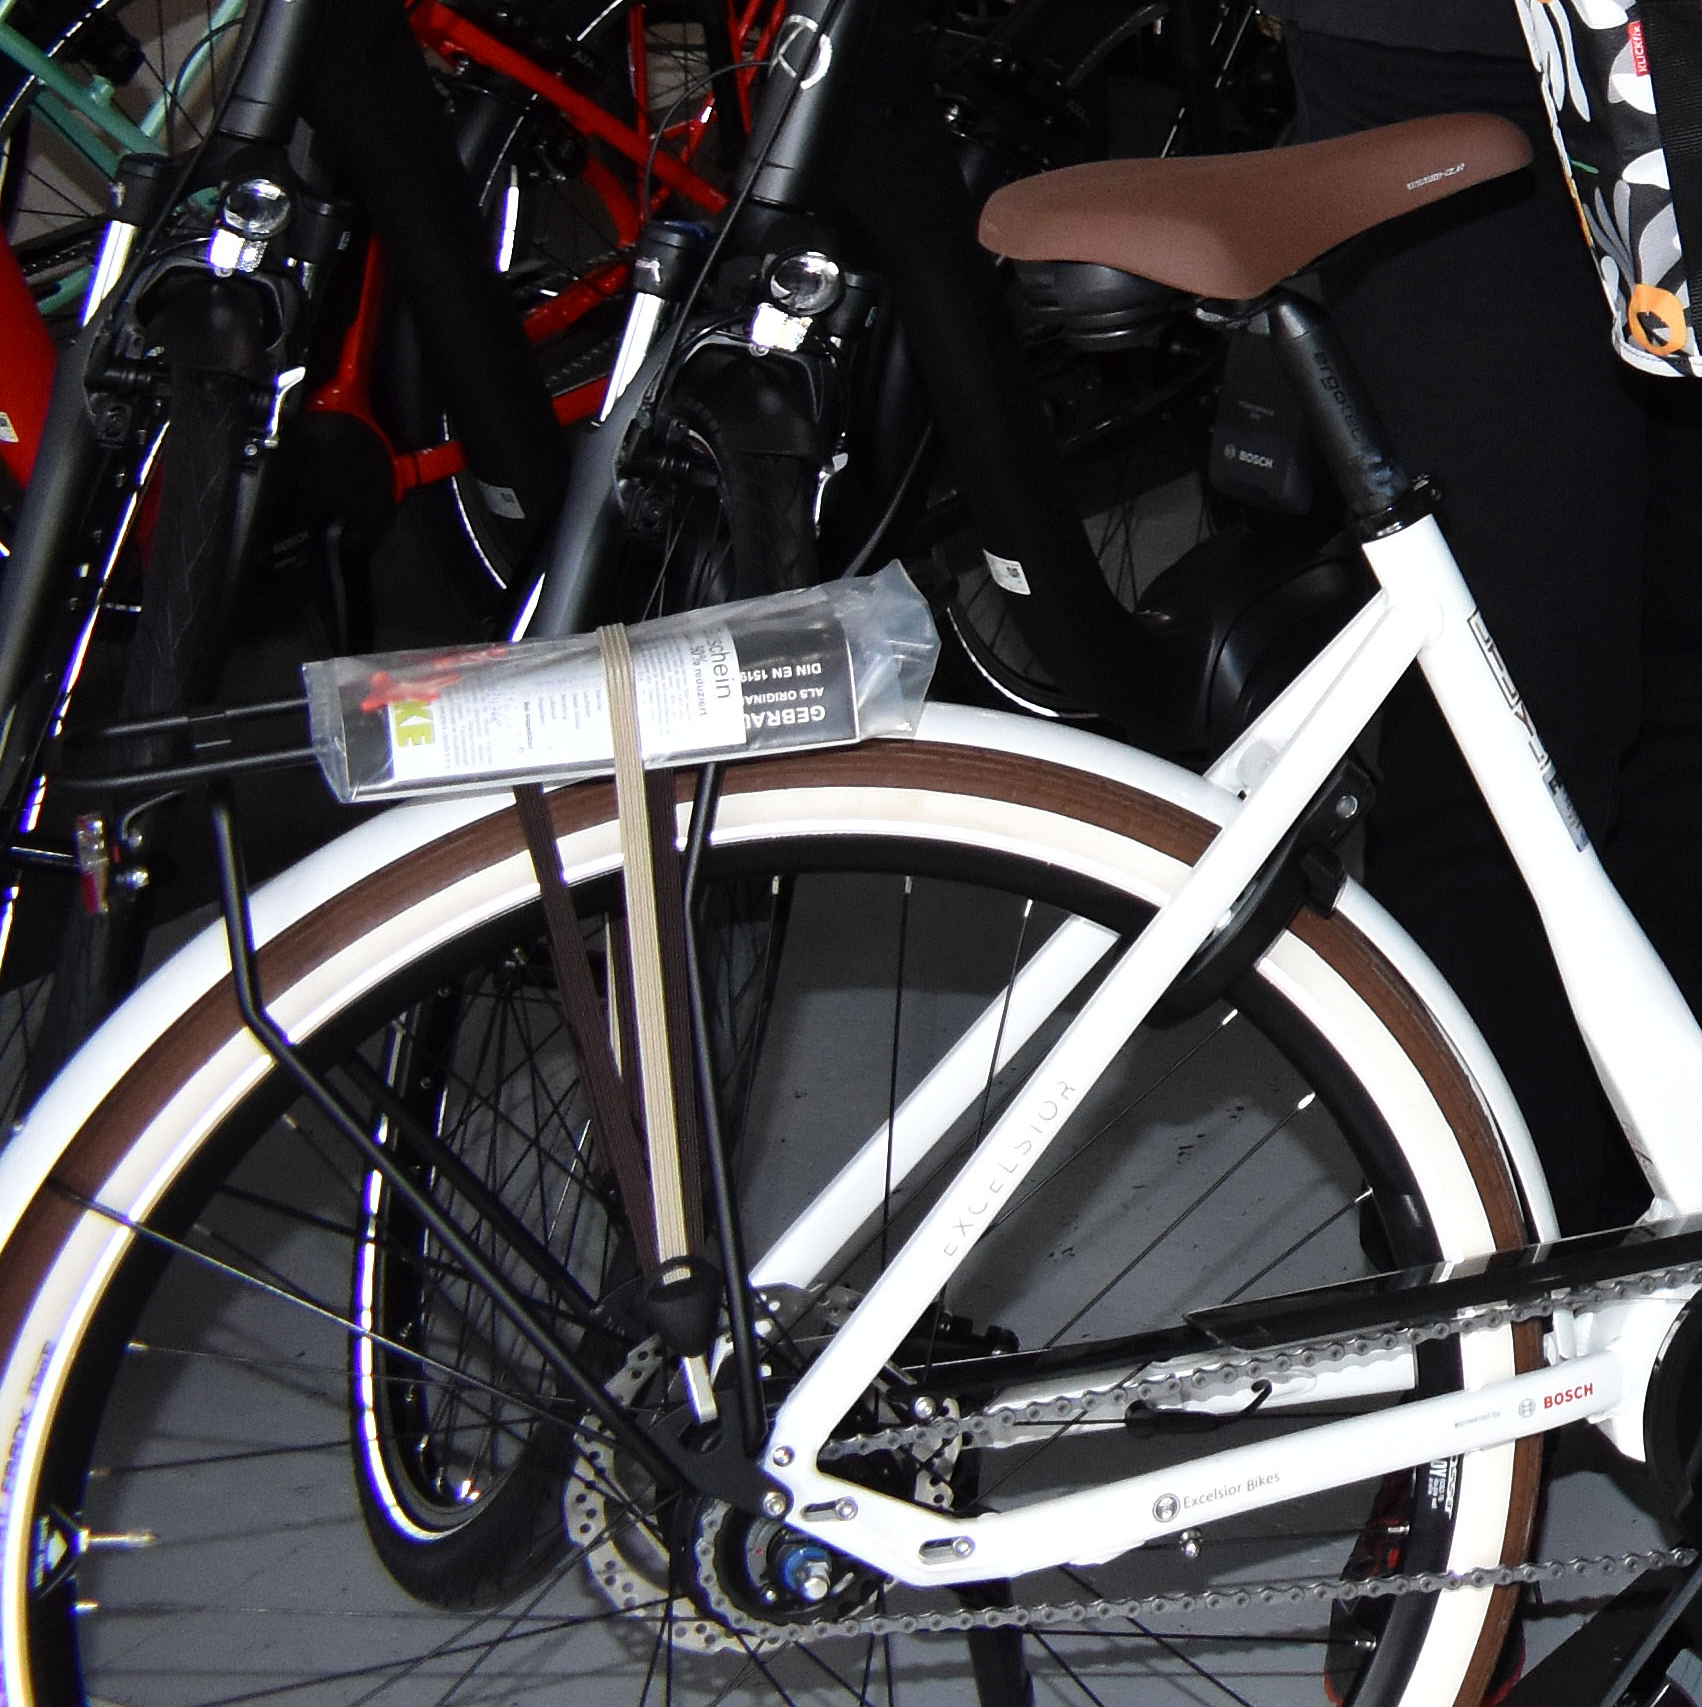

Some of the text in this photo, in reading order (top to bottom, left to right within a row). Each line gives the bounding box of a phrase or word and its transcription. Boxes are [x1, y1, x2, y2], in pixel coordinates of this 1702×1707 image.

[771, 665, 794, 680] EN
[796, 662, 823, 676] DIN
[799, 686, 825, 700] ALS
[1543, 1383, 1594, 1410] BOSCH
[1183, 1471, 1282, 1510] Excelsior Bikes
